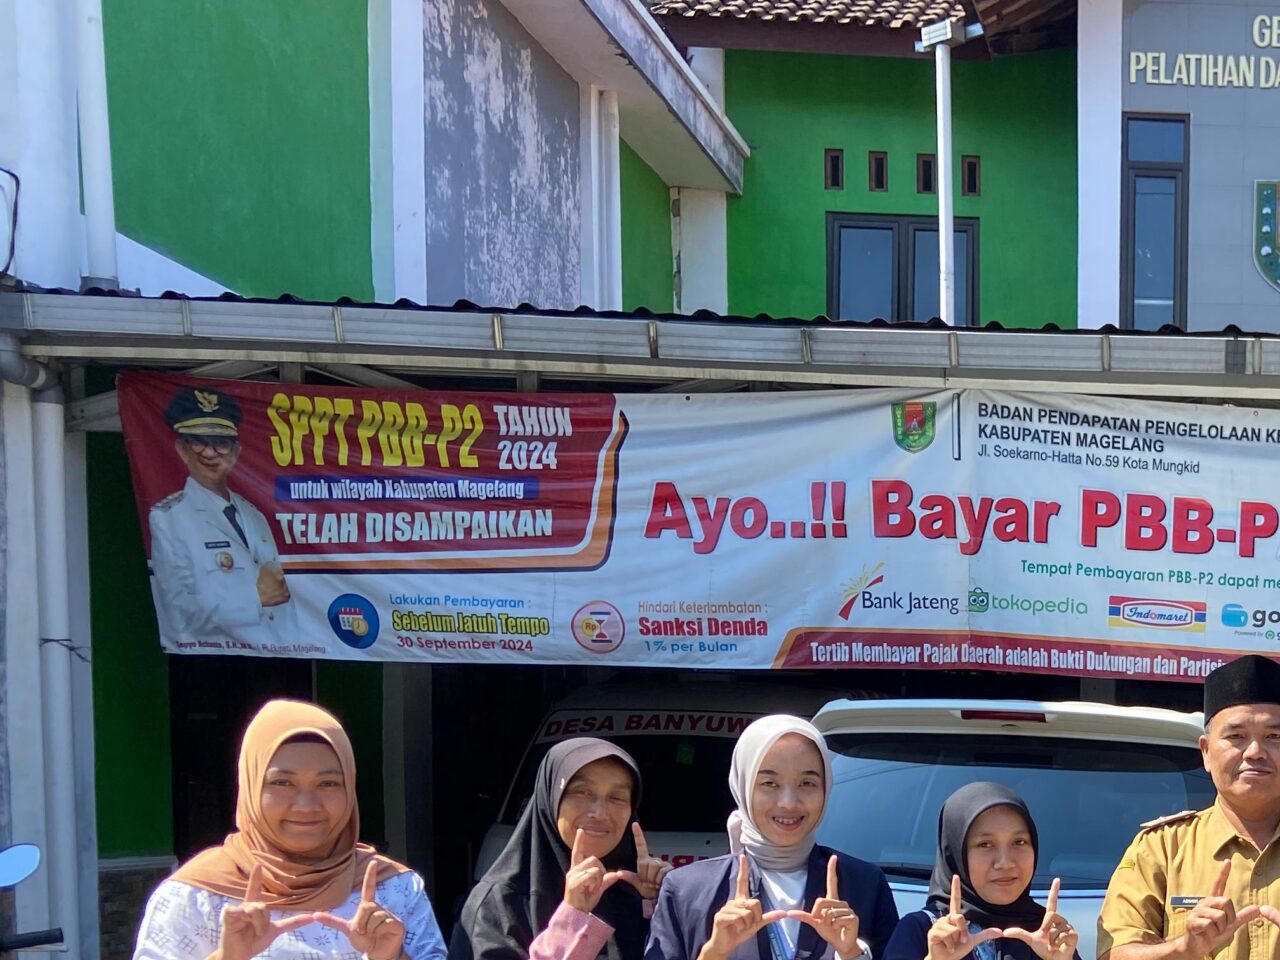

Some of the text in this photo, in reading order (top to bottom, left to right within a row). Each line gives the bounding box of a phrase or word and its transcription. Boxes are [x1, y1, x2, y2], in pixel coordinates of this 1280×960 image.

[1129, 52, 1256, 87] PELATIHAN
[267, 393, 485, 468] SPPT PBB-P2
[494, 405, 573, 437] TAHUN
[978, 403, 1033, 422] BADAN
[1037, 409, 1141, 432] PENDAPATAN
[1145, 420, 1261, 442] PENGELOLAAN
[978, 424, 1164, 453] KABUPATEN MAGELANG
[498, 441, 558, 470] 2024
[978, 444, 1200, 475] Jl. Soekarno-Hatta No.59 Kota Mungkid
[290, 478, 524, 501] untuk wilayah Kabupaten Magelang
[276, 509, 553, 544] TELAH DISAMPAIKAN
[871, 479, 1062, 555] Bayar
[1021, 559, 1072, 577] Tempat
[1076, 563, 1164, 582] Pembayaran
[1168, 570, 1214, 585] PBB-P2
[1217, 573, 1259, 590] dapat
[389, 593, 440, 606] Lakukan
[444, 595, 524, 610] Pembayaran
[638, 600, 676, 613] Hindari
[679, 601, 762, 614] Keterlambatan
[862, 591, 959, 615] Bank Jateng
[992, 594, 1088, 615] tokopedia
[1126, 607, 1189, 623] Indomaret
[392, 610, 551, 637] Sebelum Jatuh Tempo
[584, 622, 597, 632] Rp
[638, 617, 768, 636] Sanksi Denda
[396, 636, 533, 651] 30 September 2024
[671, 642, 695, 654] per
[699, 641, 738, 652] Bulan
[810, 642, 850, 662] Tertib
[852, 643, 920, 664] Membayar
[923, 643, 958, 664] Pajak
[960, 643, 1003, 664] Daerah
[1006, 647, 1048, 668] adalah
[1050, 649, 1084, 670] Bukti
[1087, 651, 1150, 674] Dukungan
[1153, 655, 1177, 675] dan
[544, 714, 753, 737] DESA BANYUW
